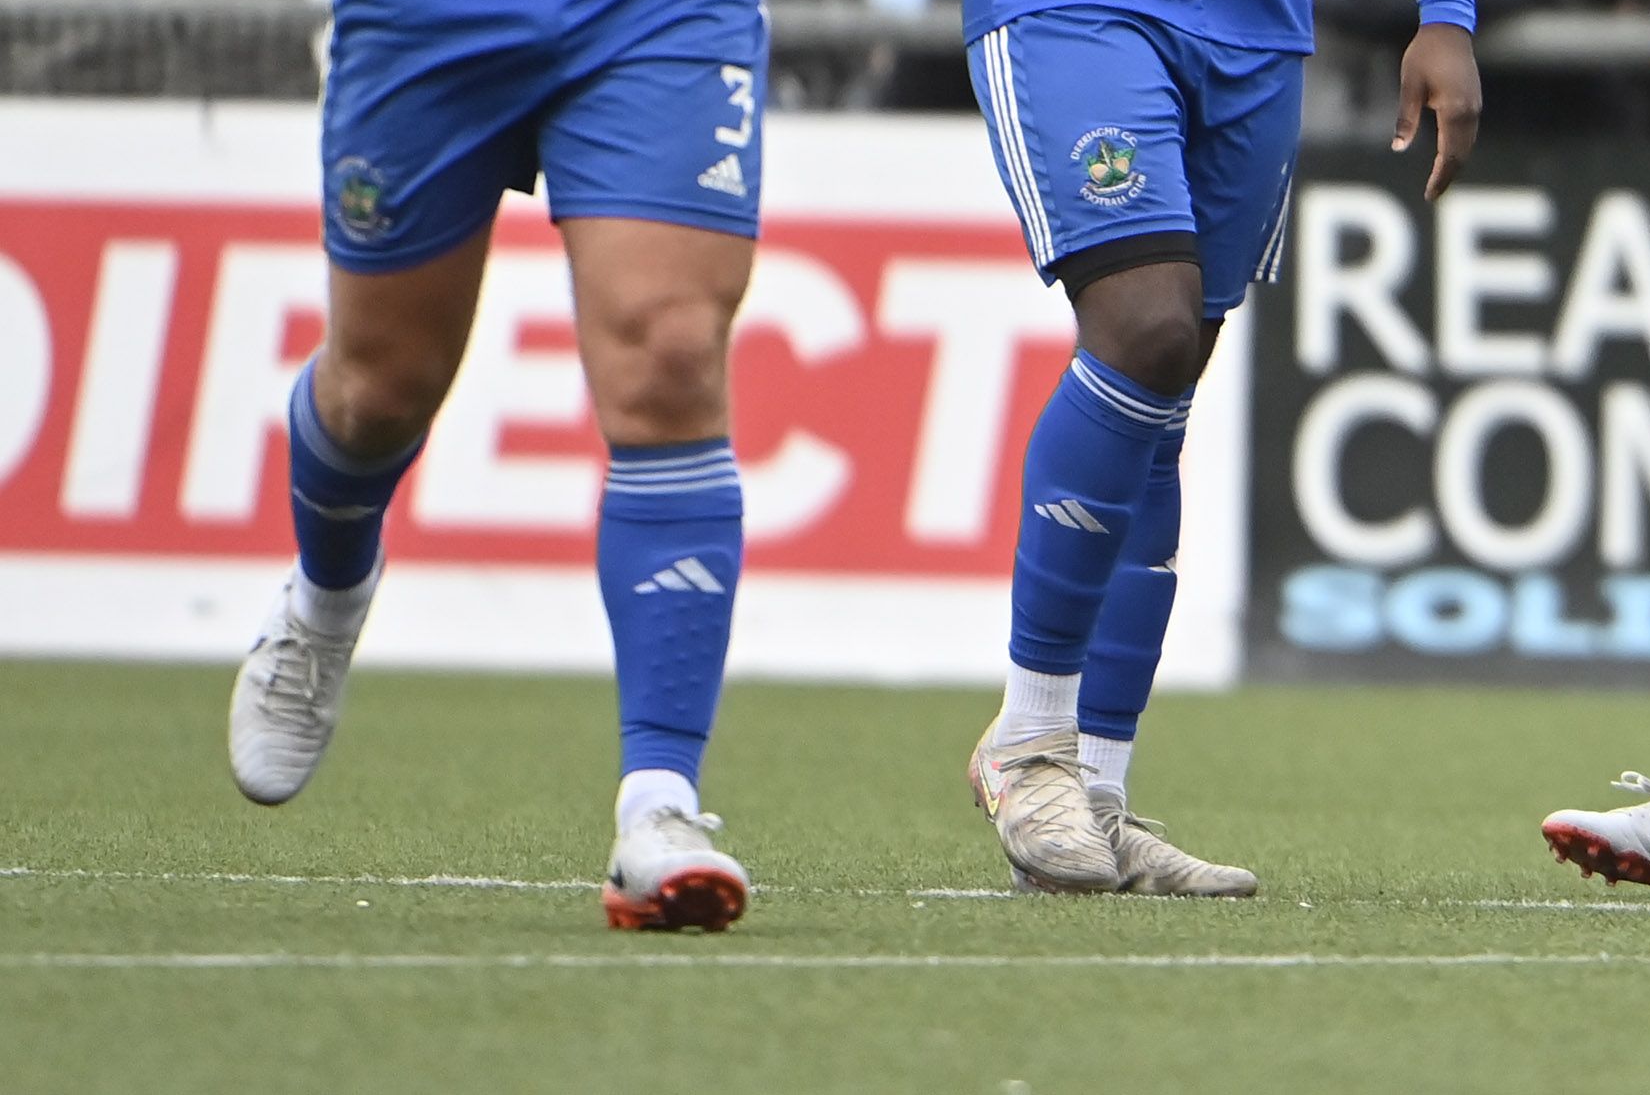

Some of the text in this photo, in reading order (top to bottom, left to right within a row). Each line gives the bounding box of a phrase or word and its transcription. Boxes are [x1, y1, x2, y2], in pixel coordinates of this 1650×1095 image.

[714, 64, 756, 149] 3
[1070, 126, 1121, 161] DERRIAGHY
[1080, 174, 1147, 207] FOOTBALL CLUB
